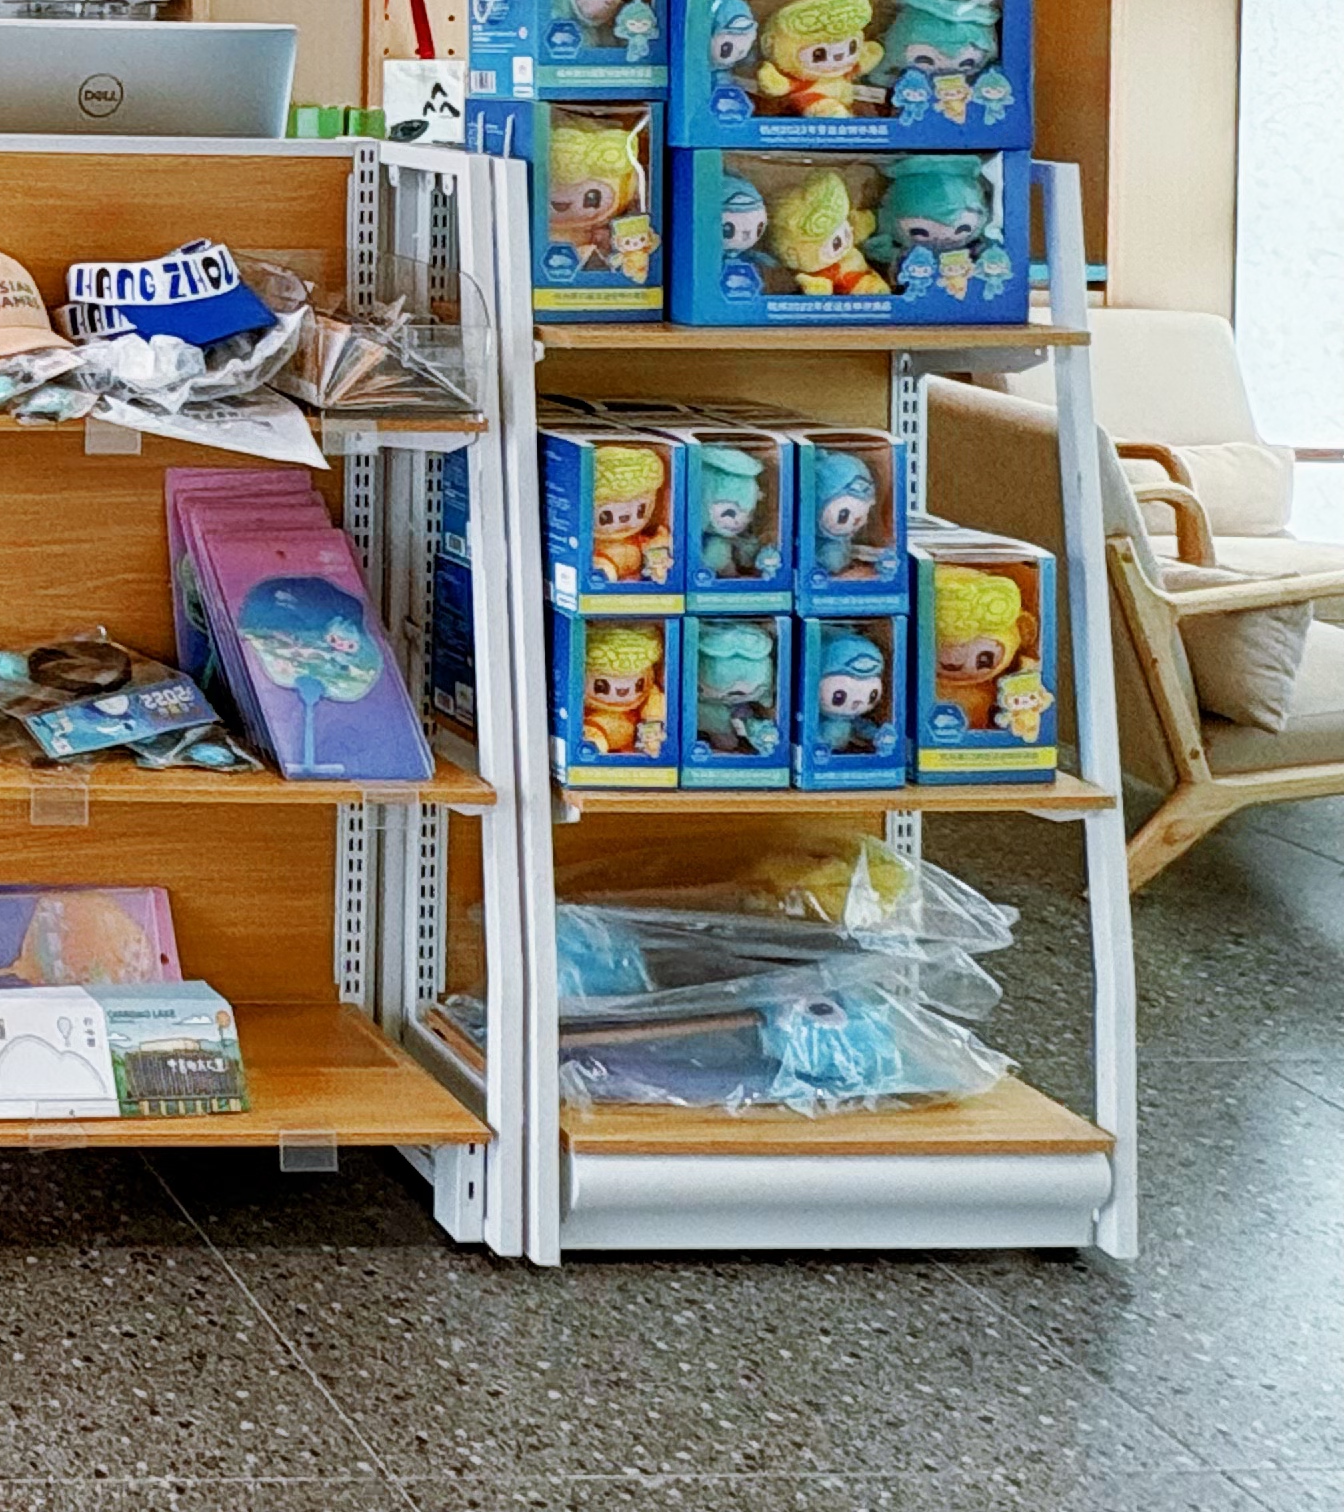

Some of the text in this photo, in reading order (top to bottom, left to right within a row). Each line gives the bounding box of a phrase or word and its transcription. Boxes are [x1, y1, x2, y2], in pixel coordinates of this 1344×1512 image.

[84, 90, 118, 102] DELL
[75, 249, 235, 301] HANG ZHOU
